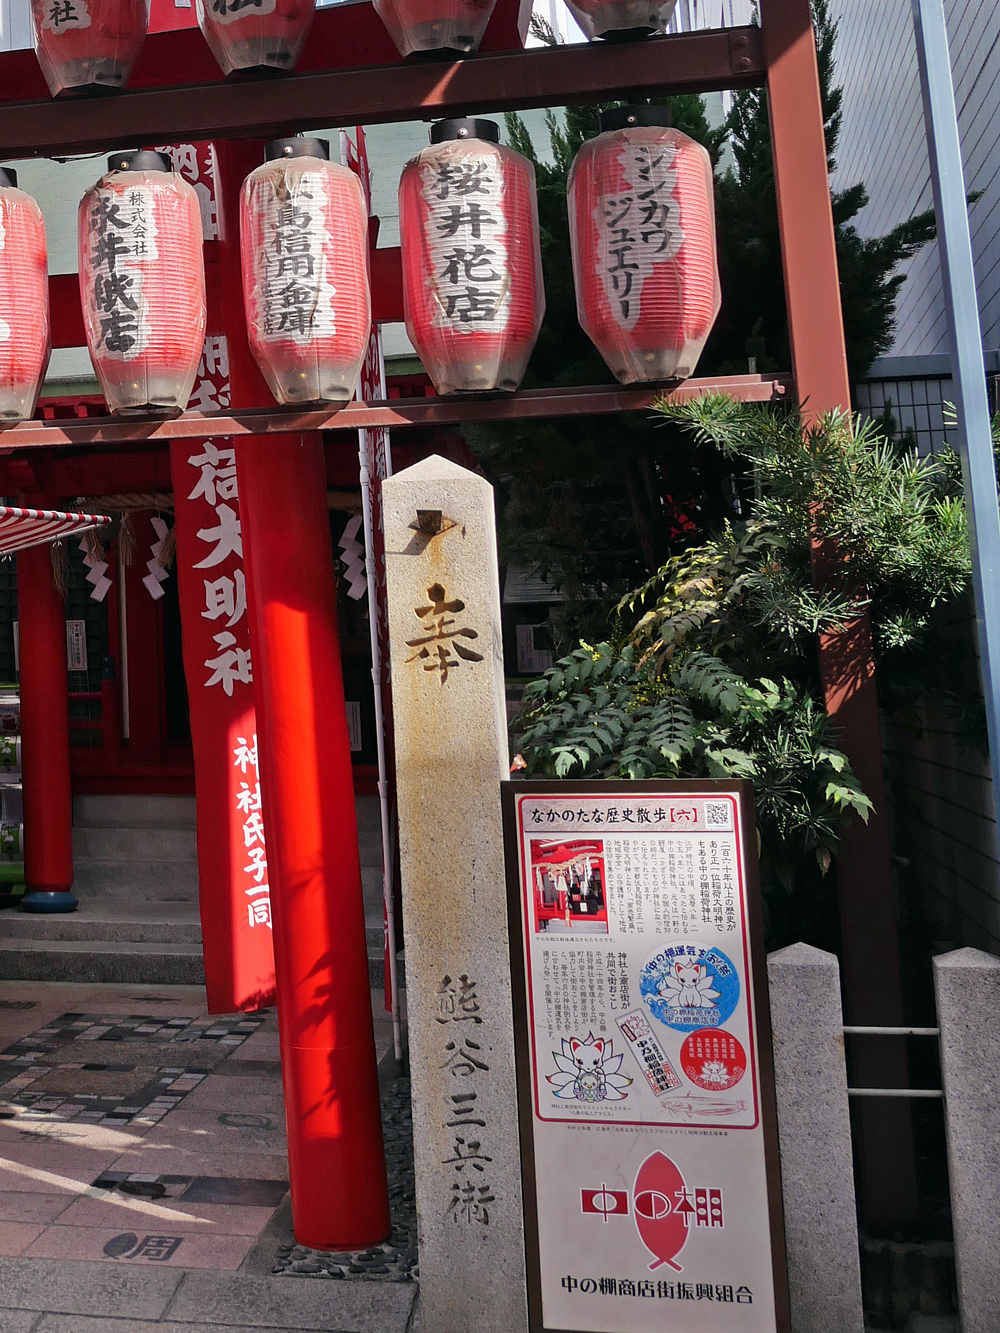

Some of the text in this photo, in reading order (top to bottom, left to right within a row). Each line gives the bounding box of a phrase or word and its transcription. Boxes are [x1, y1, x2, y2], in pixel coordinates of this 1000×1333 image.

[128, 191, 149, 256] 株式会社
[432, 161, 502, 323] 桜井花店
[634, 146, 673, 253] シンカワ
[258, 248, 275, 335] 八丁堀支店
[603, 196, 640, 320] ジュエリー
[404, 582, 485, 685] 奉
[531, 807, 698, 824] なかのたな歴史散歩【六】
[697, 840, 712, 923] もある中の棚稲荷神社
[709, 840, 724, 932] あり正一位稲荷大明神で
[720, 841, 737, 932] 二百六十年以上の歴史が
[605, 952, 618, 1010] 共同で街おこし
[617, 952, 631, 1010] 神社と商店街が
[560, 1275, 754, 1305] 中の棚商店街振興組合
